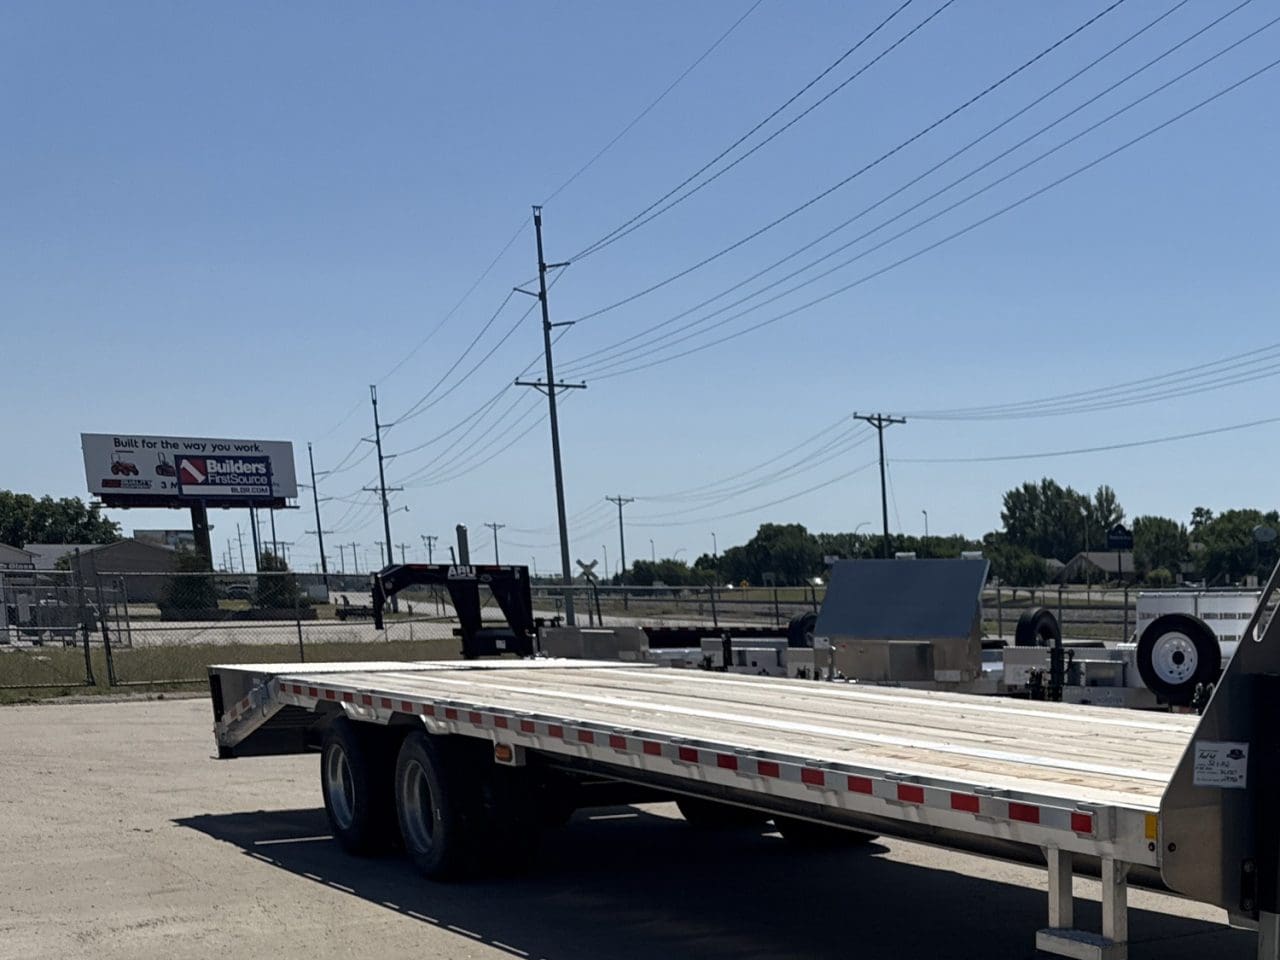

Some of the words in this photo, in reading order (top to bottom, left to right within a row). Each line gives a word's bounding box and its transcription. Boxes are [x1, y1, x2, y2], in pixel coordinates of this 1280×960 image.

[113, 437, 138, 449] Built
[142, 438, 158, 449] for
[161, 439, 179, 450] the
[183, 441, 207, 453] way
[211, 442, 231, 453] you
[234, 442, 263, 452] work.
[206, 459, 267, 474] Builders
[207, 473, 268, 485] FirstSource
